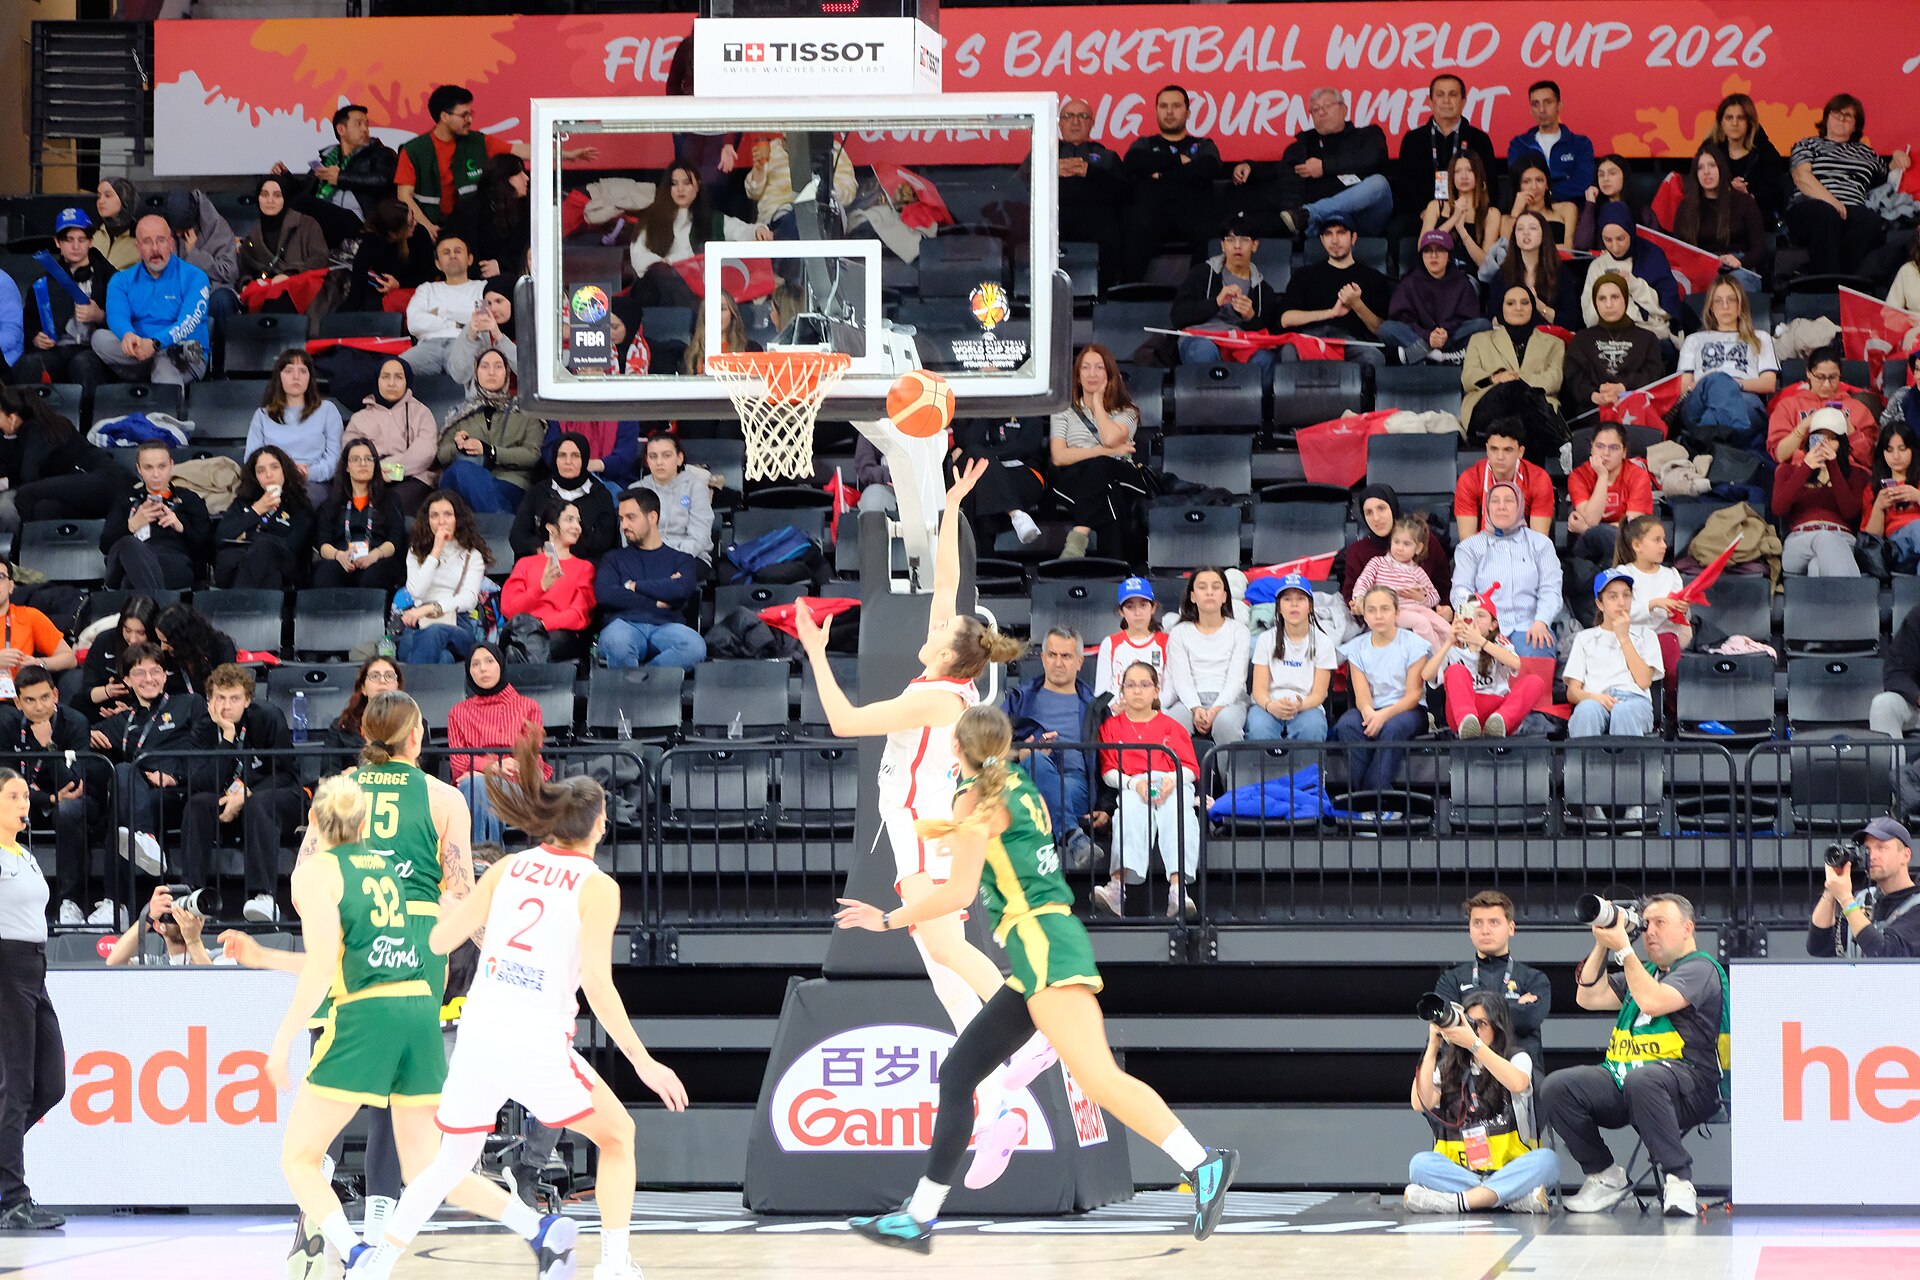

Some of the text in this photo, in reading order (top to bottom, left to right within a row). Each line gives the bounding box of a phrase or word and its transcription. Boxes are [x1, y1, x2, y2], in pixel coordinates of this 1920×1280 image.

[604, 36, 685, 83] FIB
[1003, 24, 1306, 77] BASKETBALL
[1325, 22, 1500, 70] WORLD
[1520, 21, 1634, 69] CUP
[1645, 24, 1773, 68] 2026
[722, 66, 757, 74] SWISS
[763, 66, 815, 74] WATCHES
[821, 66, 855, 74] SINCE
[769, 42, 885, 62] TISSOT
[575, 330, 605, 347] FIBA
[952, 346, 984, 355] WORLD
[985, 346, 1003, 355] CUP
[357, 771, 410, 786] GEORGE
[362, 791, 400, 839] 15
[510, 859, 580, 891] UZUN
[362, 875, 406, 928] 32
[507, 897, 545, 952] 2
[367, 935, 419, 969] Ford
[64, 1025, 278, 1126] ada
[1781, 1020, 1920, 1124] he
[787, 1087, 1028, 1147] Gant
